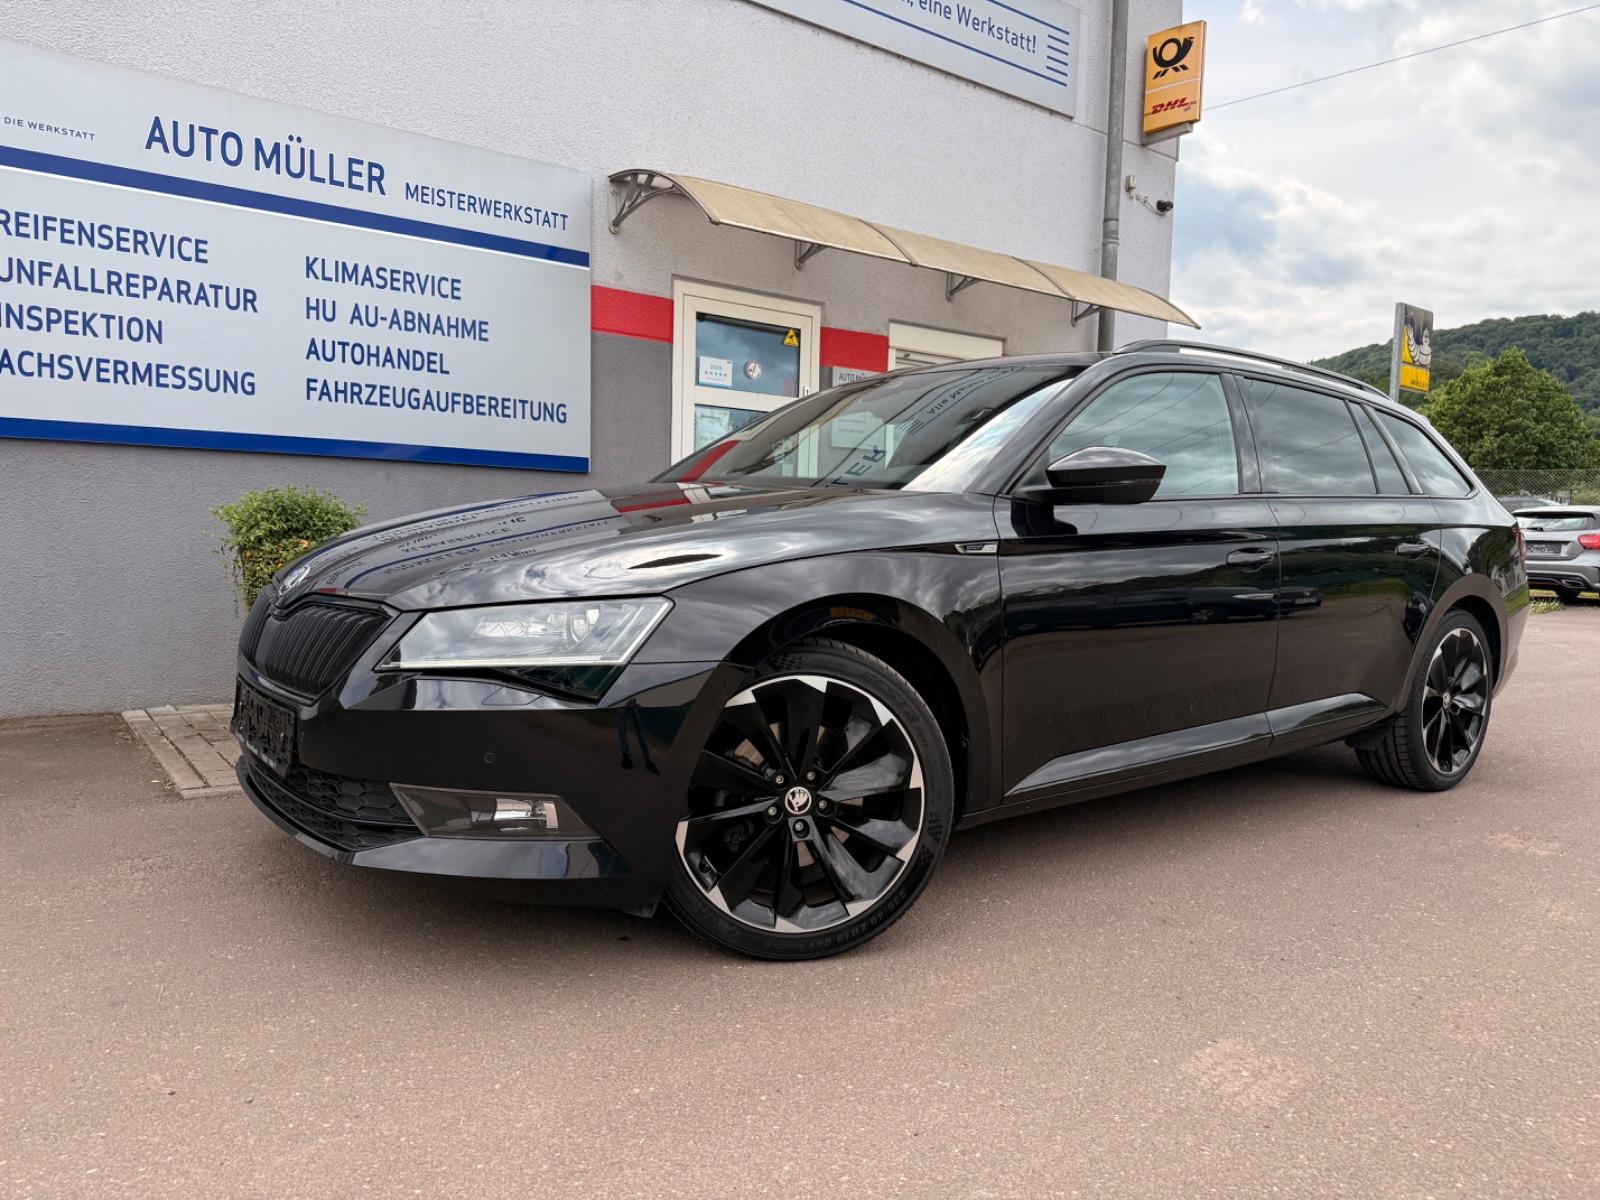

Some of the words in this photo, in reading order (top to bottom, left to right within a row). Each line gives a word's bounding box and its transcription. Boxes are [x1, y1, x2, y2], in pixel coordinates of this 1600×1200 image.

[956, 3, 1037, 54] Werkstatt!
[4, 116, 24, 127] DIE
[27, 121, 96, 141] WERKSTATT
[1151, 97, 1189, 115] DHL
[145, 115, 243, 167] AUTO
[253, 135, 386, 196] MÜLLER
[404, 182, 569, 231] MEISTERWERKSTATT
[0, 208, 208, 264] REIFENSERVICE
[0, 256, 259, 313] UNFALLREPARATUR
[305, 255, 462, 301] KLIMASERVICE
[305, 296, 337, 323] HU
[349, 303, 489, 343] AU-ABNAHME
[0, 348, 256, 396] ACHSVERMESSUNG
[305, 337, 450, 376] AUTOHANDEL
[305, 378, 567, 424] FAHRZEUGAUFBEREITUNG
